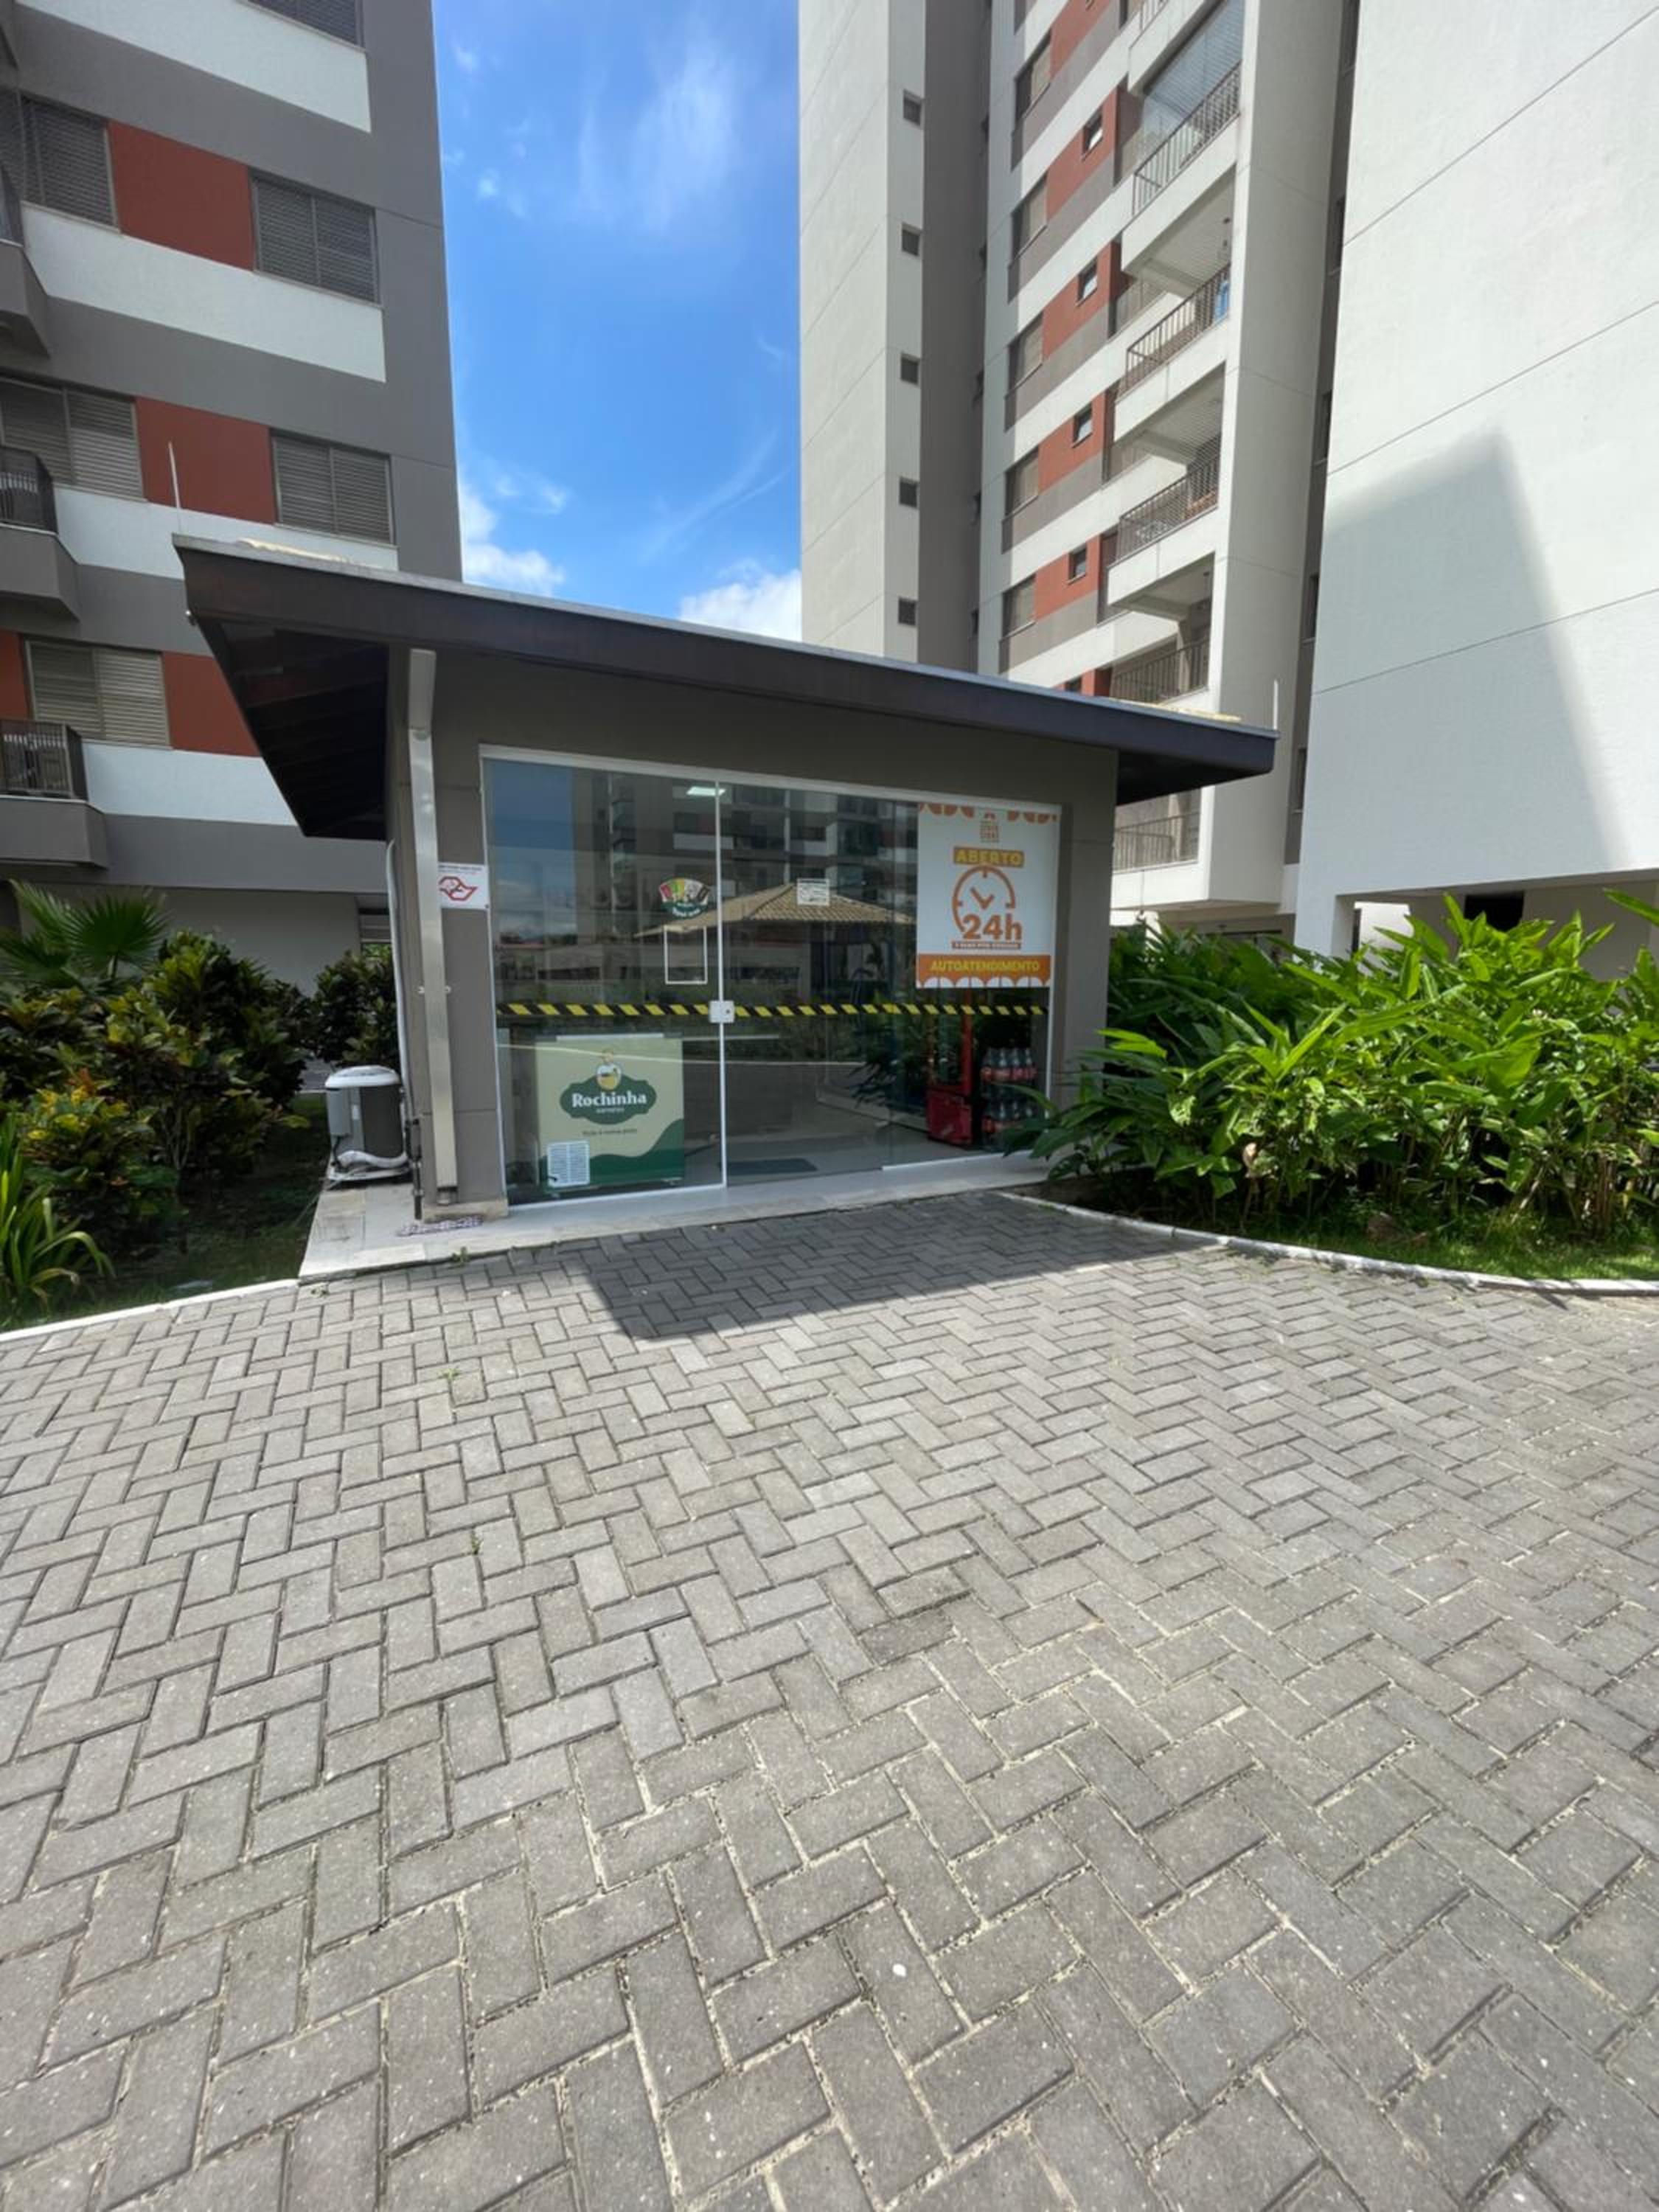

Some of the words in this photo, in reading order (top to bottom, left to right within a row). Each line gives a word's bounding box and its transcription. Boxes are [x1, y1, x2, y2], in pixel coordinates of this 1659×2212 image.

[956, 849, 1023, 866] ABERTO
[962, 913, 1023, 940] 24h
[930, 959, 1040, 972] AUTOATENDIMENTO
[571, 1090, 647, 1107] Rochinha
